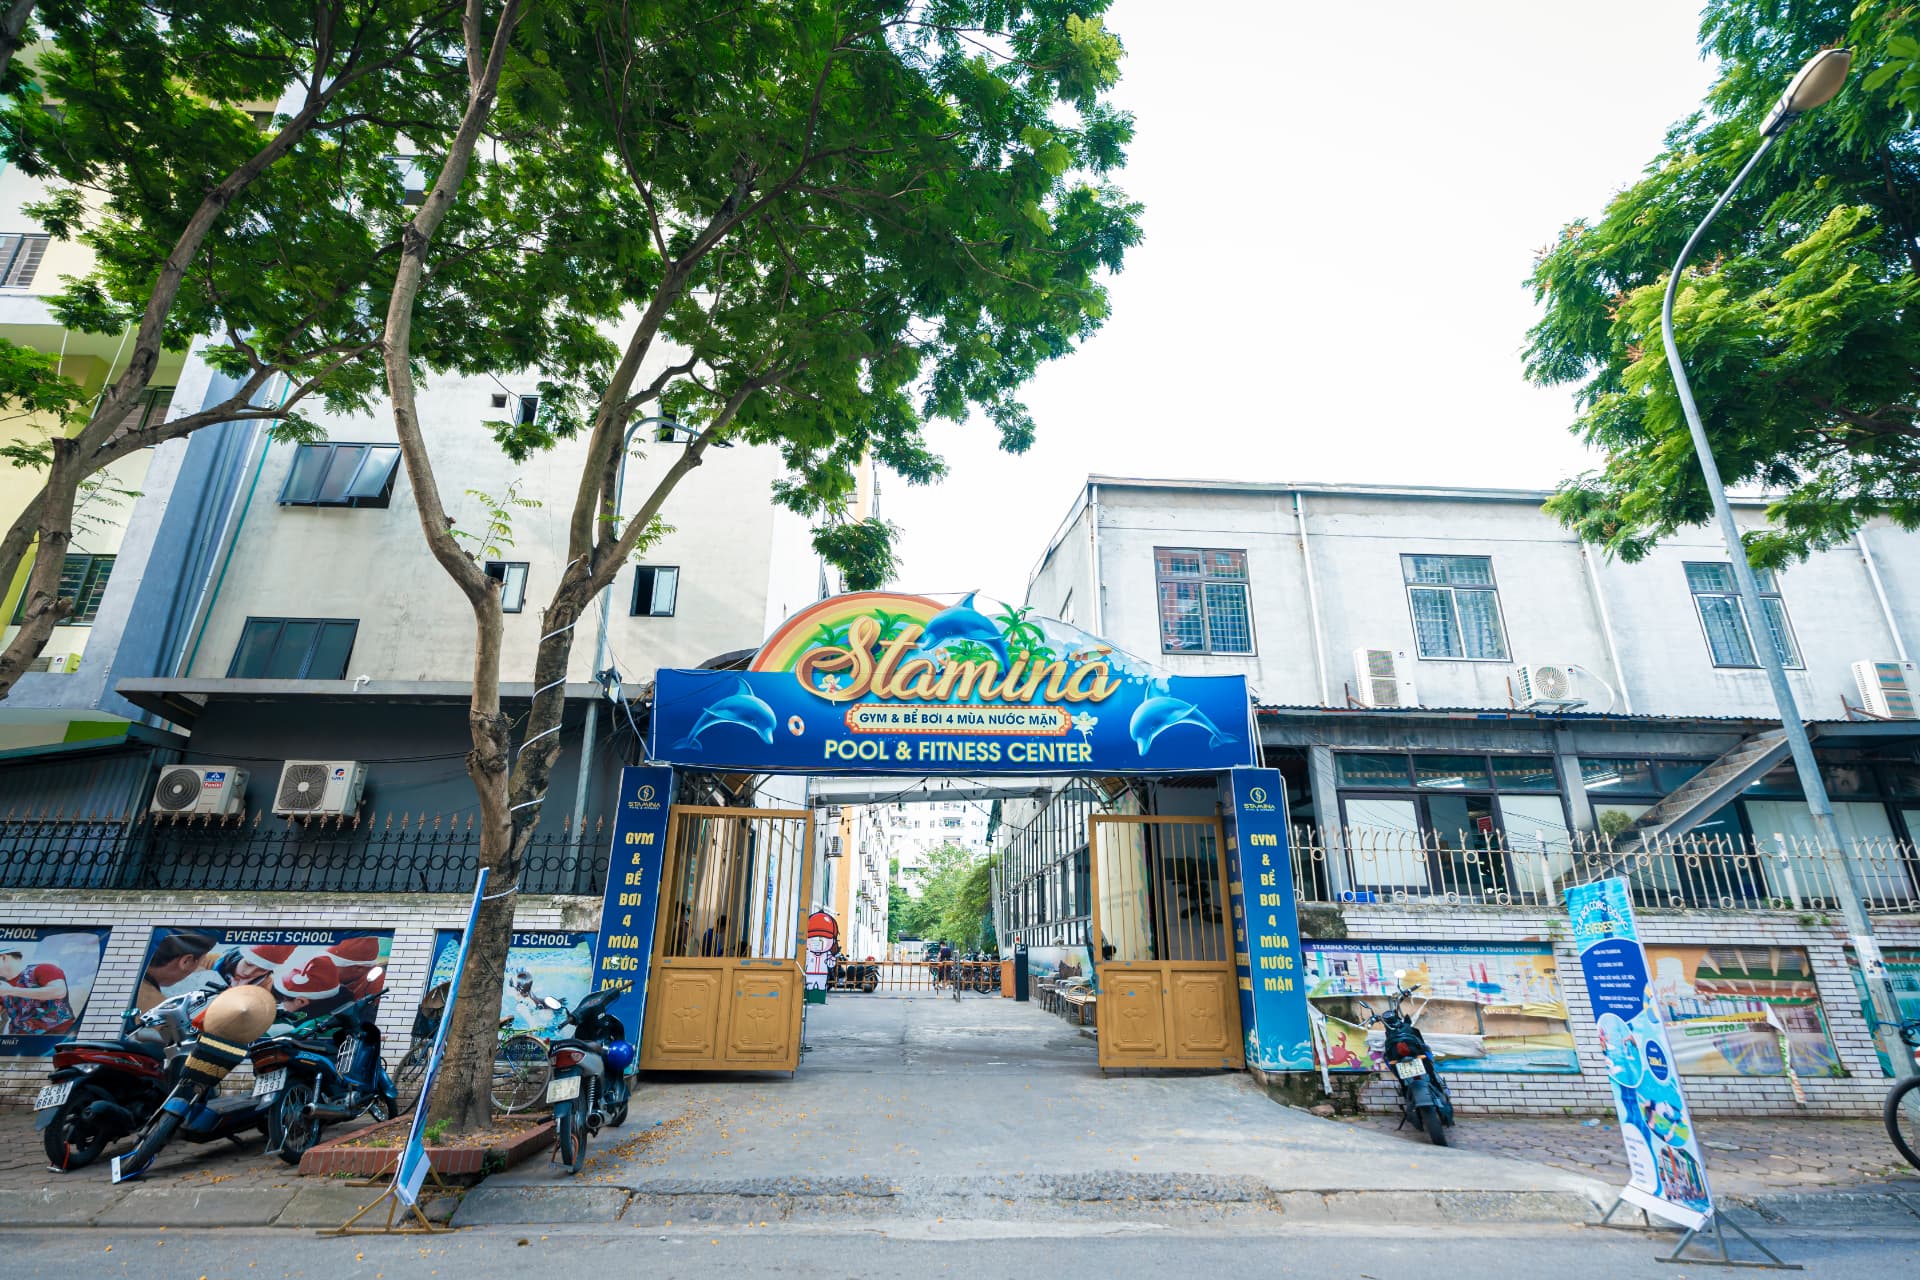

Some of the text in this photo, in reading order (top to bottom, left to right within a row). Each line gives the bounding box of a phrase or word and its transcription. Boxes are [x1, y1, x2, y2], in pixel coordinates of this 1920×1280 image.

[795, 615, 1122, 702] Stamina
[859, 709, 1057, 728] GYM & BỂ BƠI 4 MÙA NƯỚC MẶN
[824, 740, 1093, 763] POOL & FITNESS CENTER
[625, 832, 654, 845] GYM
[1250, 834, 1277, 846] GYM
[631, 852, 641, 865] &
[1261, 853, 1271, 866] &
[625, 868, 643, 885] BỂ
[1260, 869, 1276, 886] BỂ
[618, 892, 642, 906] BƠI
[1259, 893, 1280, 906] BƠI
[622, 914, 632, 927] 4
[1268, 914, 1277, 927] 4
[225, 930, 335, 943] EVEREST SCHOOL
[522, 934, 572, 946] SCHOOL
[607, 933, 639, 948] MÙA
[1260, 933, 1289, 948] MÙA
[1259, 953, 1294, 970] NƯỚC
[1264, 976, 1294, 994] MẶN
